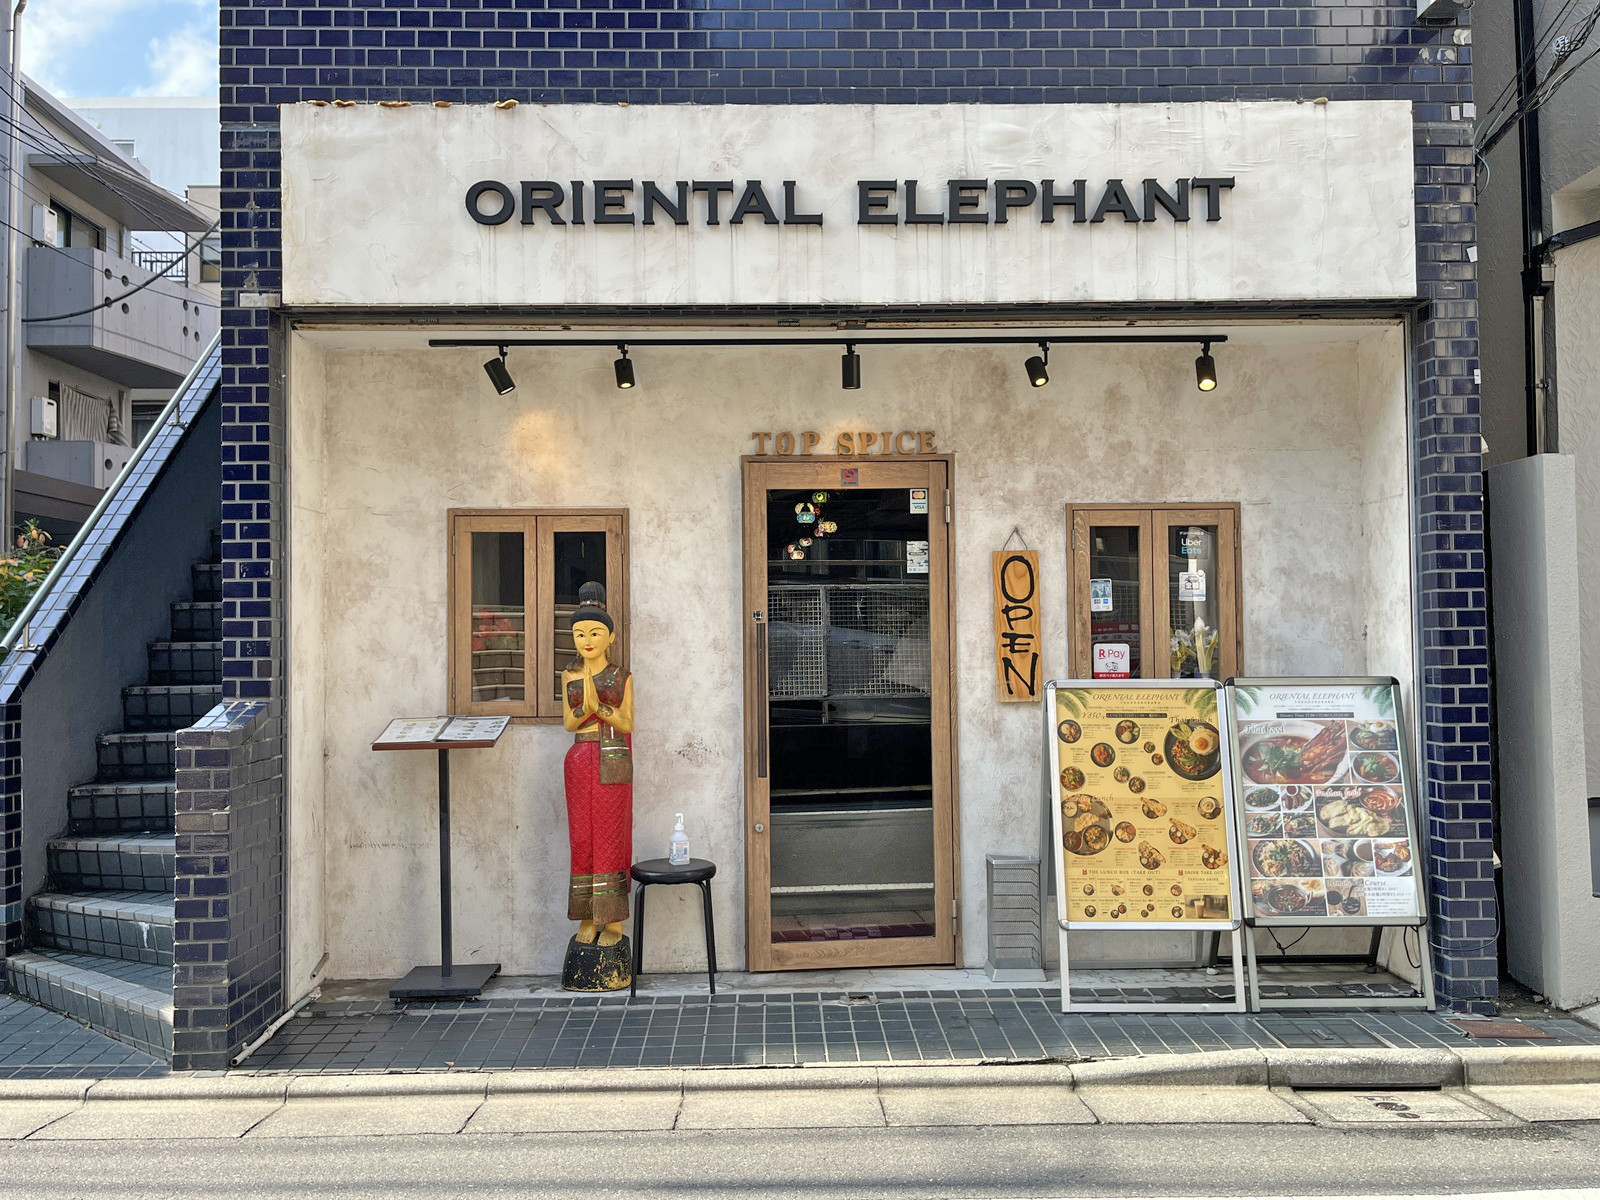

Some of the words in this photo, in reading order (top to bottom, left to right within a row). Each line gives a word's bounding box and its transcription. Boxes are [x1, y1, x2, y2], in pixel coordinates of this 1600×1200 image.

[465, 179, 823, 226] ORIENTAL
[857, 176, 1236, 225] ELEPHANT
[751, 431, 821, 456] TOP
[836, 430, 938, 456] SPICE
[1181, 538, 1202, 546] Uber
[1001, 555, 1039, 696] OPEN
[1107, 649, 1125, 660] Pay
[1092, 692, 1134, 701] ORIENTAL
[1136, 692, 1182, 700] ELEPHANT
[1269, 692, 1312, 701] ORIENTAL
[1312, 691, 1357, 700] ELEPHANT
